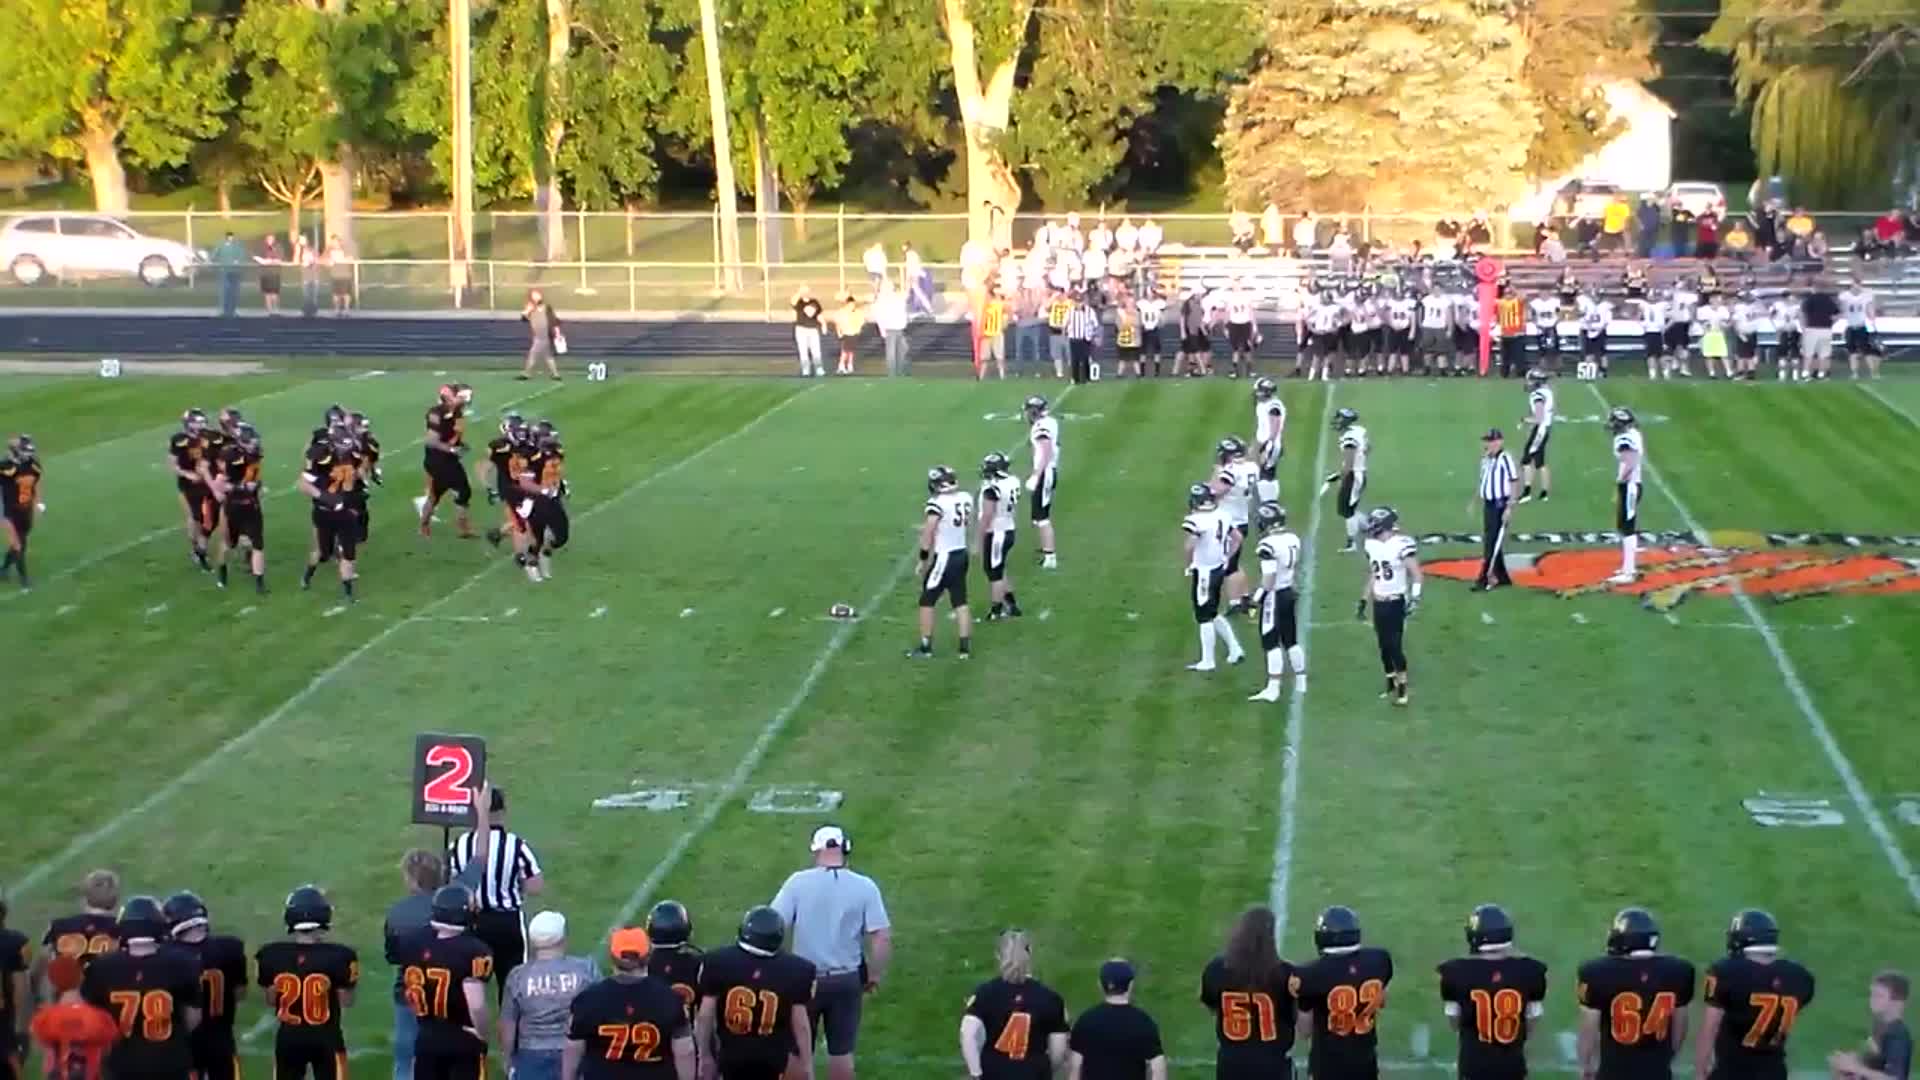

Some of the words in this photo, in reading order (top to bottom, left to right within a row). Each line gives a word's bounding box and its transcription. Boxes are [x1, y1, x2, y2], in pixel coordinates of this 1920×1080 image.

[1577, 362, 1597, 378] 50
[424, 745, 473, 804] 2
[111, 991, 173, 1041] 78
[725, 986, 779, 1035] 61
[1221, 992, 1276, 1043] 51
[1471, 989, 1523, 1045] 18
[1611, 991, 1676, 1046] 64
[1749, 993, 1800, 1048] 71
[598, 1023, 662, 1062] 72
[994, 1012, 1031, 1061] 4
